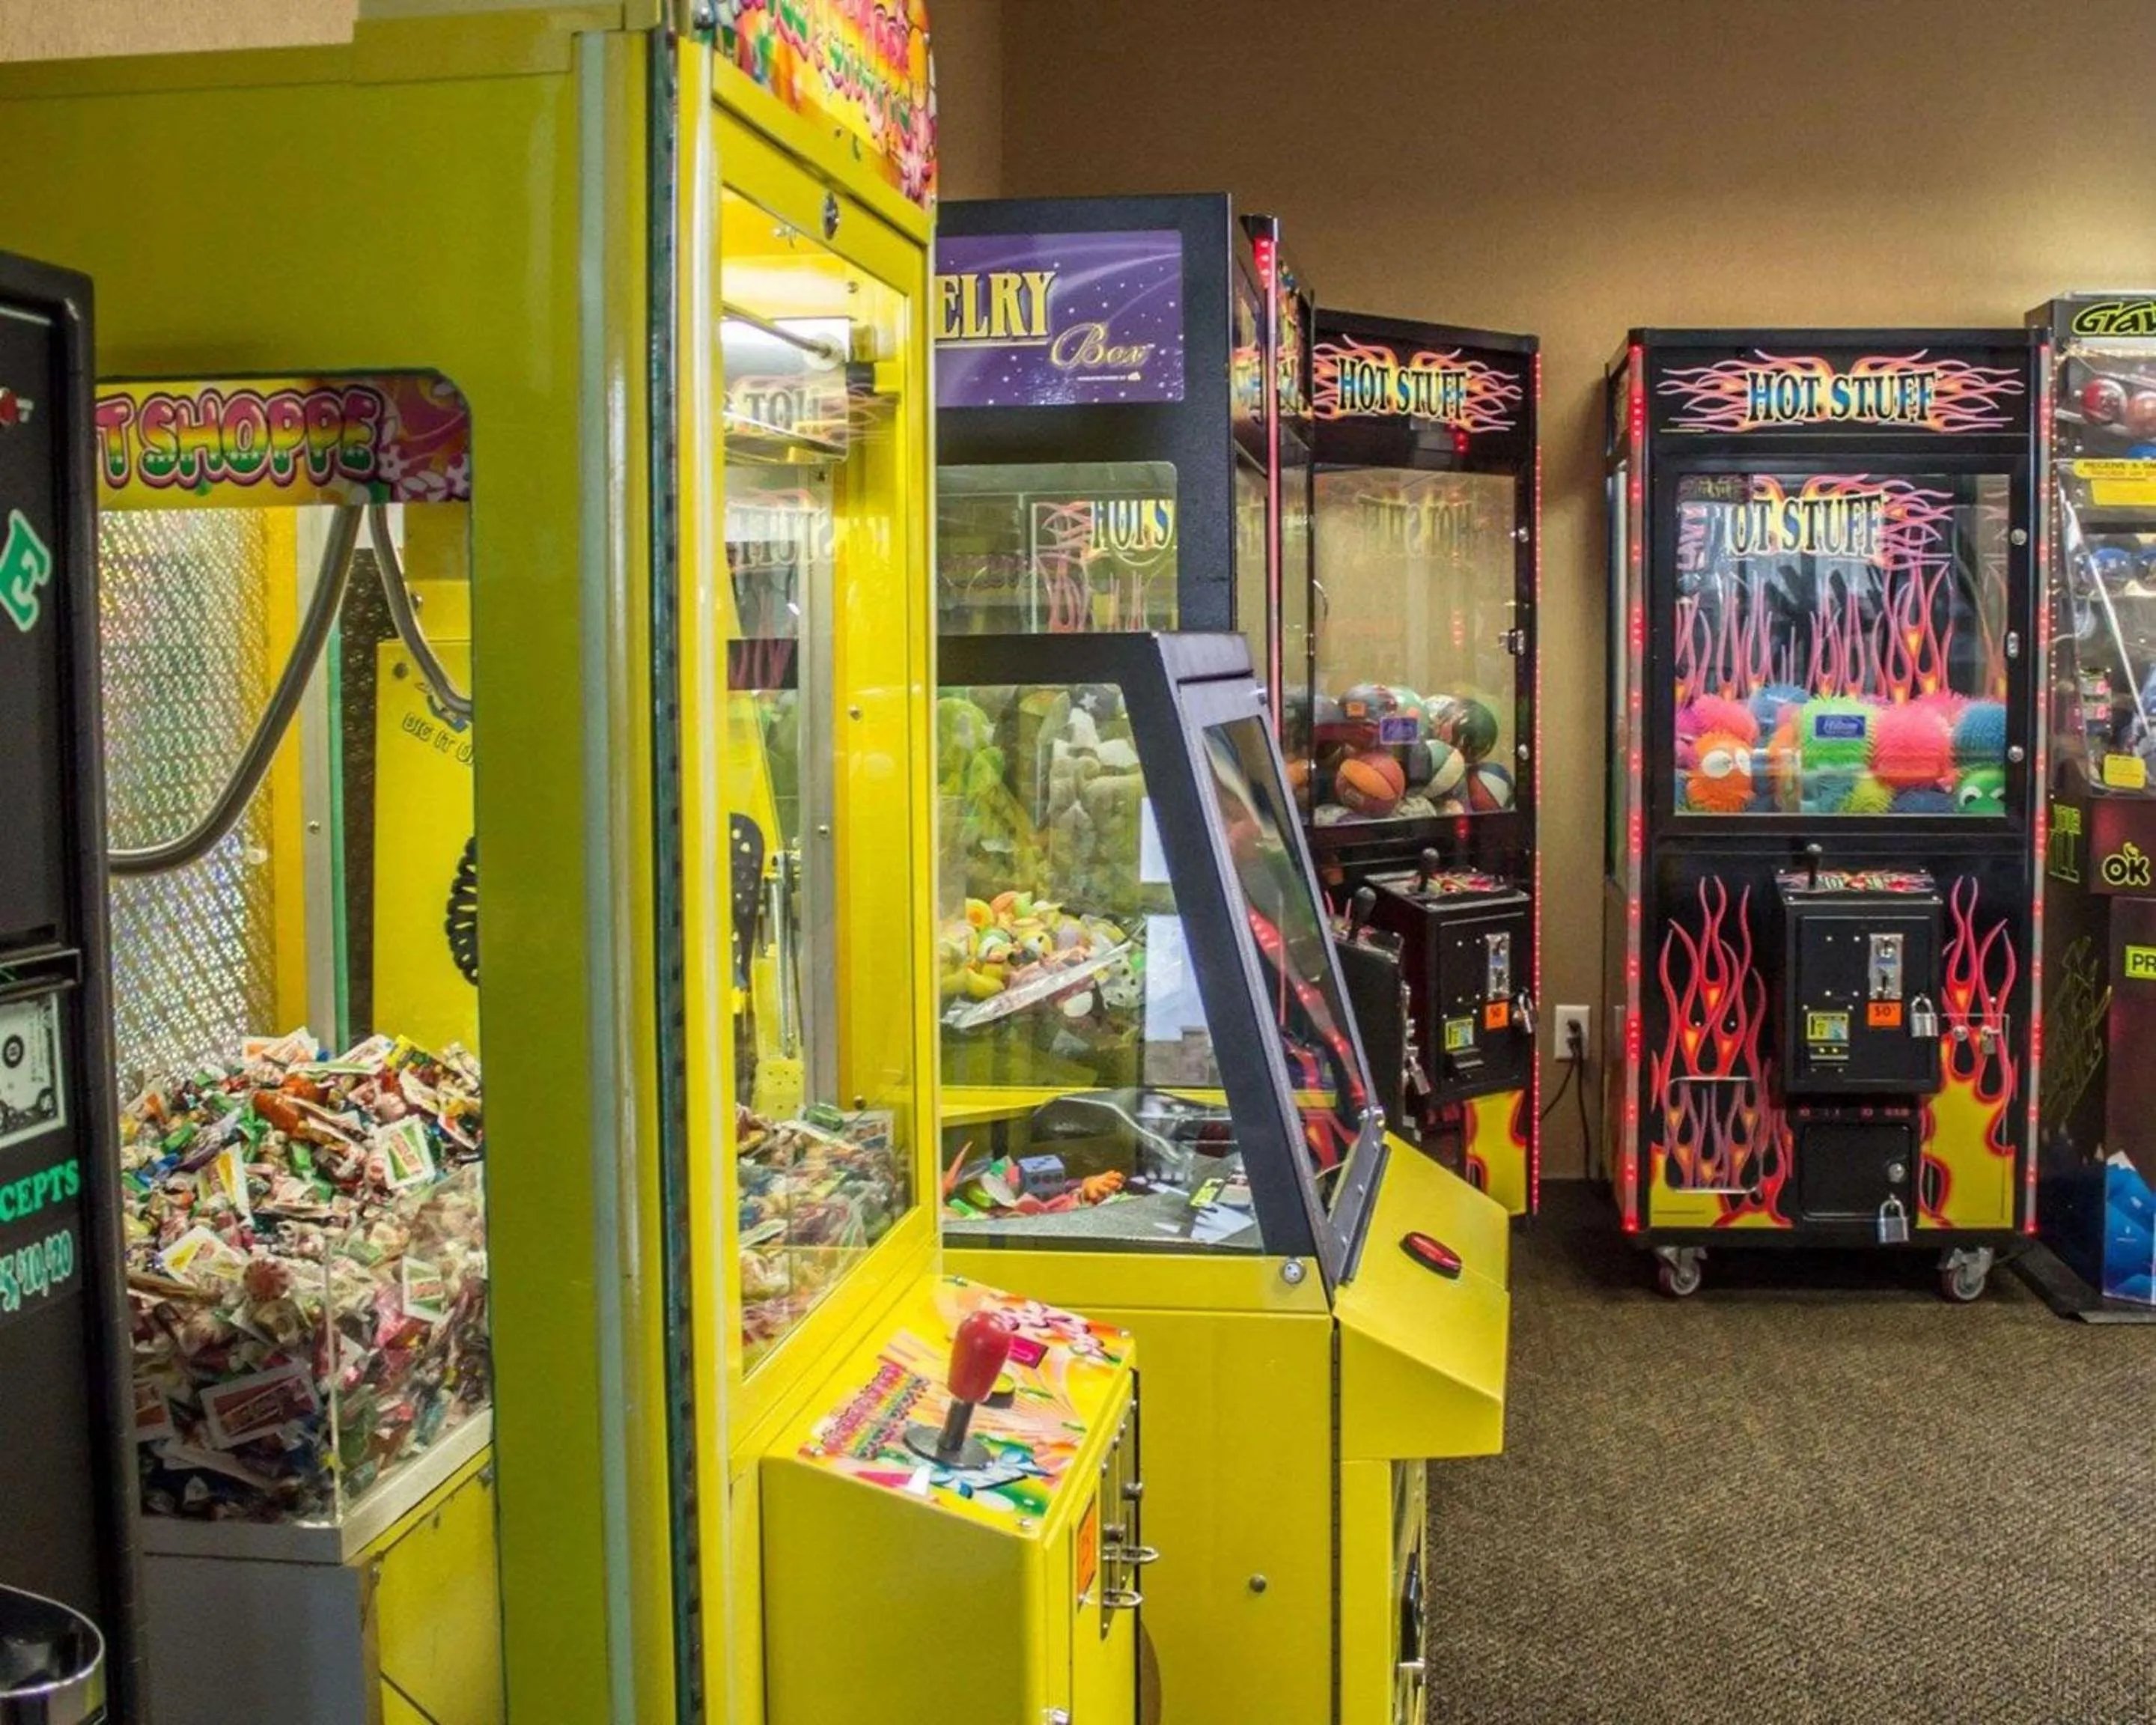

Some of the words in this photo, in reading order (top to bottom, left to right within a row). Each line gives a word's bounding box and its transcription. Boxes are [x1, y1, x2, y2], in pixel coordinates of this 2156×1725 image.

[934, 271, 1056, 338] ELRY
[1050, 321, 1154, 371] Box
[1337, 356, 1390, 413] HOT
[1397, 365, 1467, 422] STUFF
[1747, 370, 1822, 423] HOT
[1830, 370, 1937, 423] STUFF
[138, 385, 385, 490] SHOPPE
[1782, 490, 1886, 557] STUFF
[2102, 853, 2152, 886] OK
[0, 1160, 80, 1222] CEPTS
